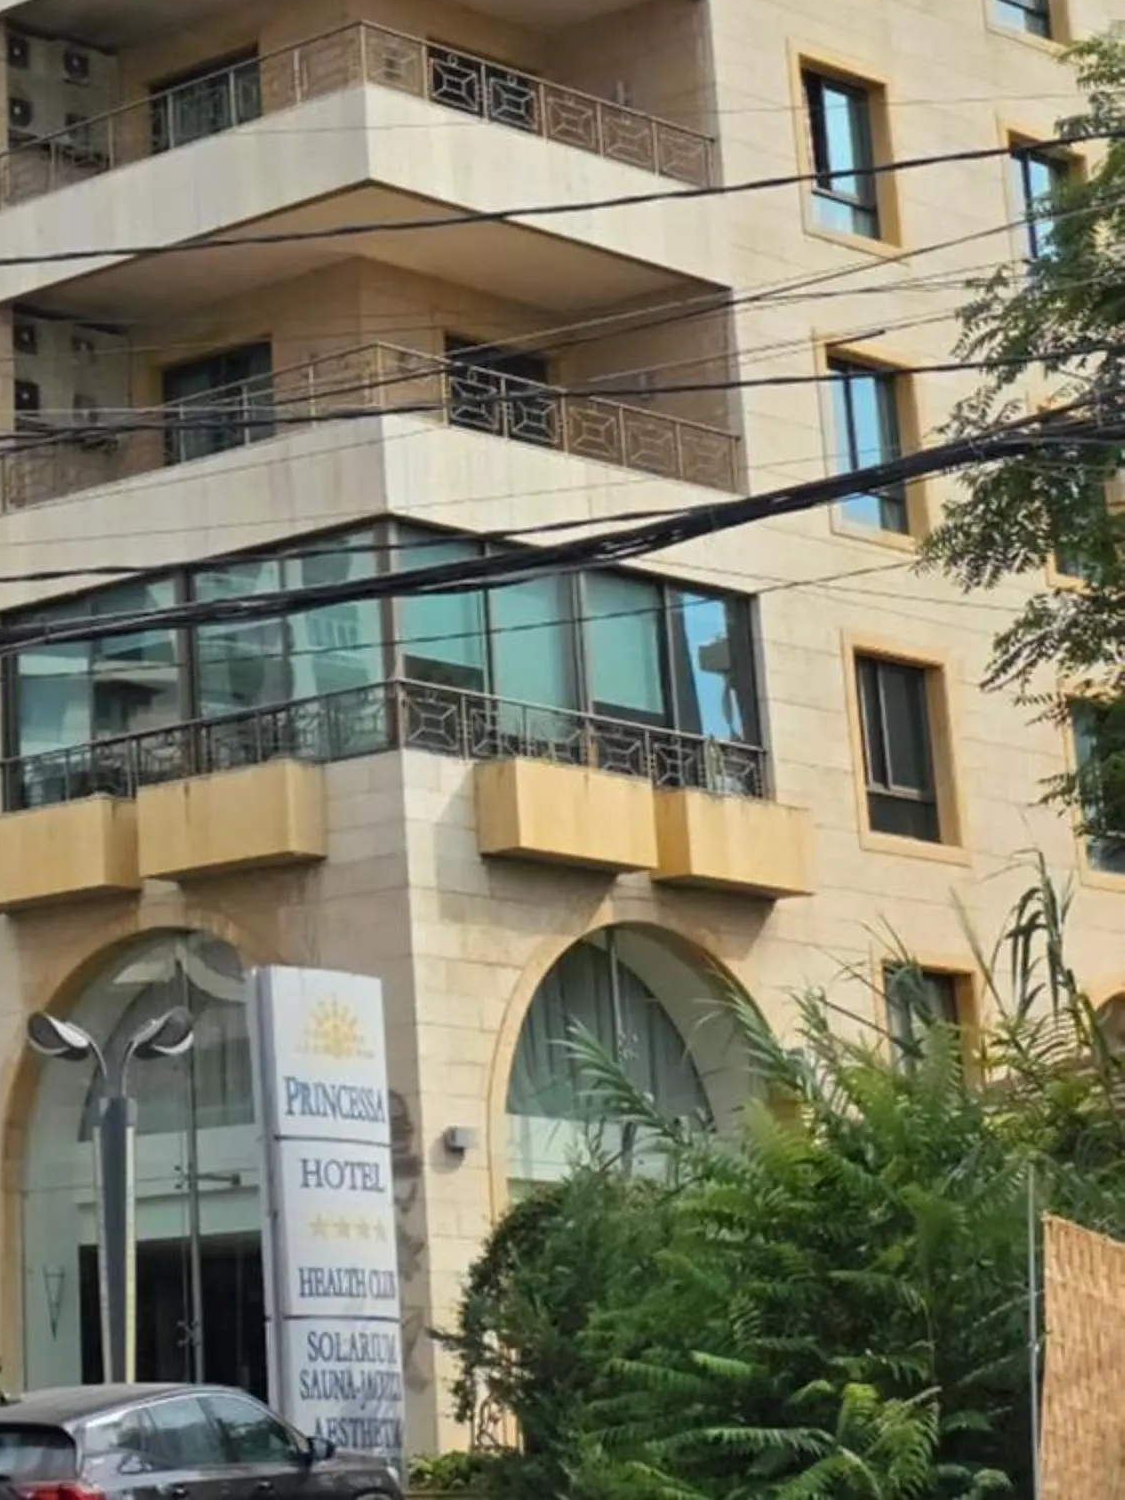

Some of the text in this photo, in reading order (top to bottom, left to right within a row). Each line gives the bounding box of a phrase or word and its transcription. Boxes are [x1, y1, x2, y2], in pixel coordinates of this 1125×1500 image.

[283, 1076, 386, 1123] PRINCESSA
[299, 1158, 385, 1193] HOTEL
[298, 1267, 367, 1298] HEALTH
[306, 1331, 397, 1364] SOLARIUM
